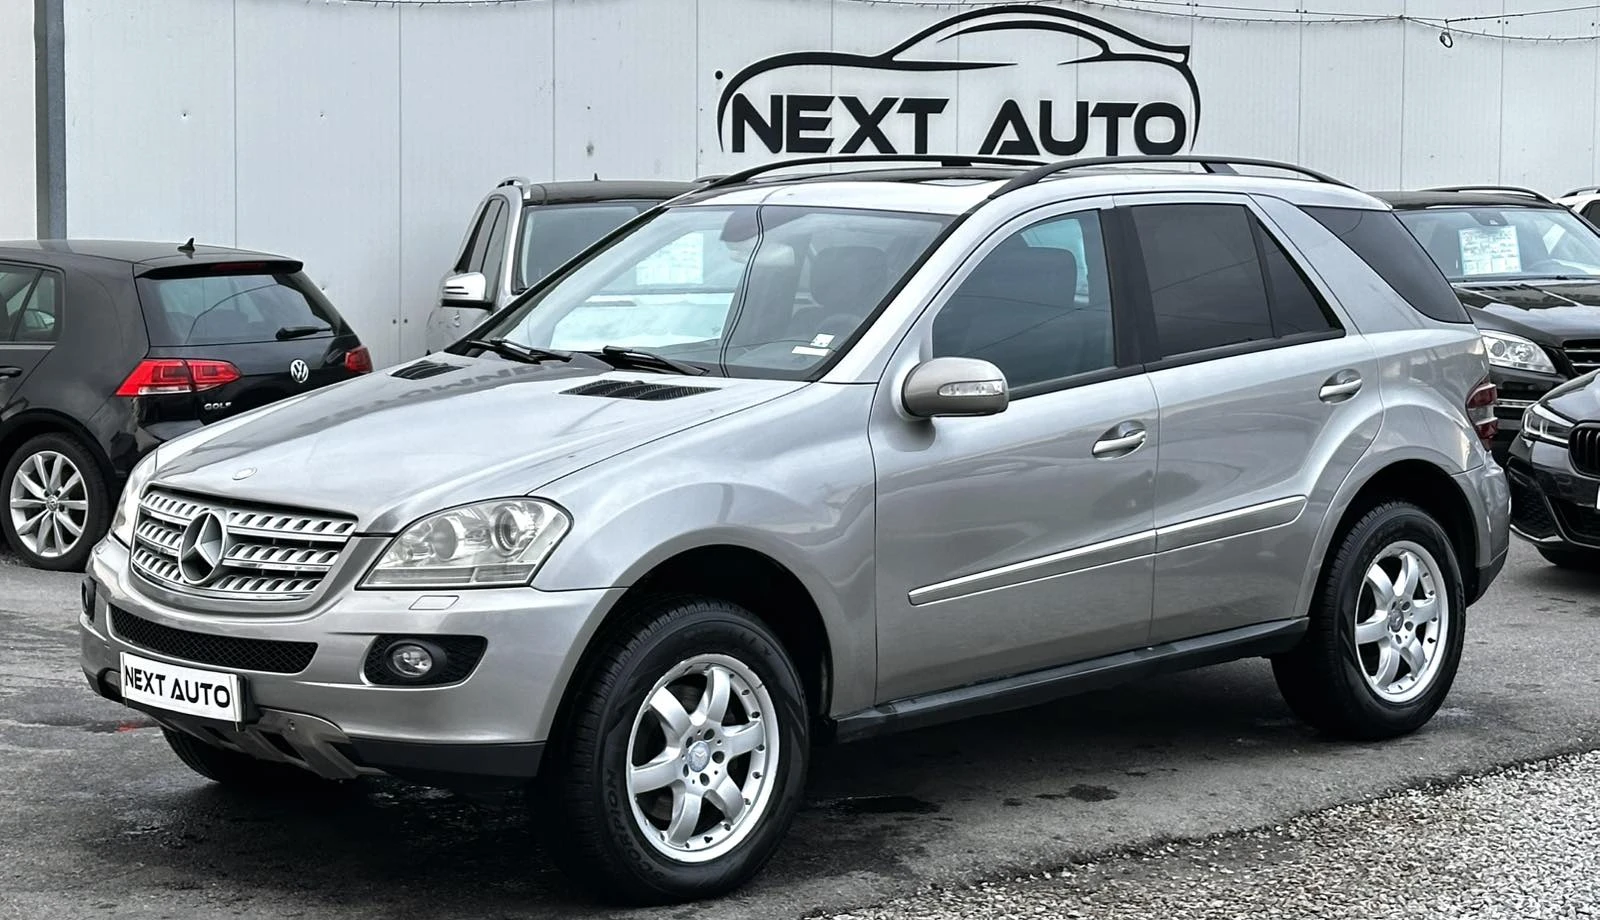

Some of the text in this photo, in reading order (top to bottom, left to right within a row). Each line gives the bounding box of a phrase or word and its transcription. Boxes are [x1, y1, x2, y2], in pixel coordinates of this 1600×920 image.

[732, 92, 1187, 156] NEXT AUTO
[204, 401, 232, 411] GOLF
[125, 665, 231, 708] NEXT AUTO
